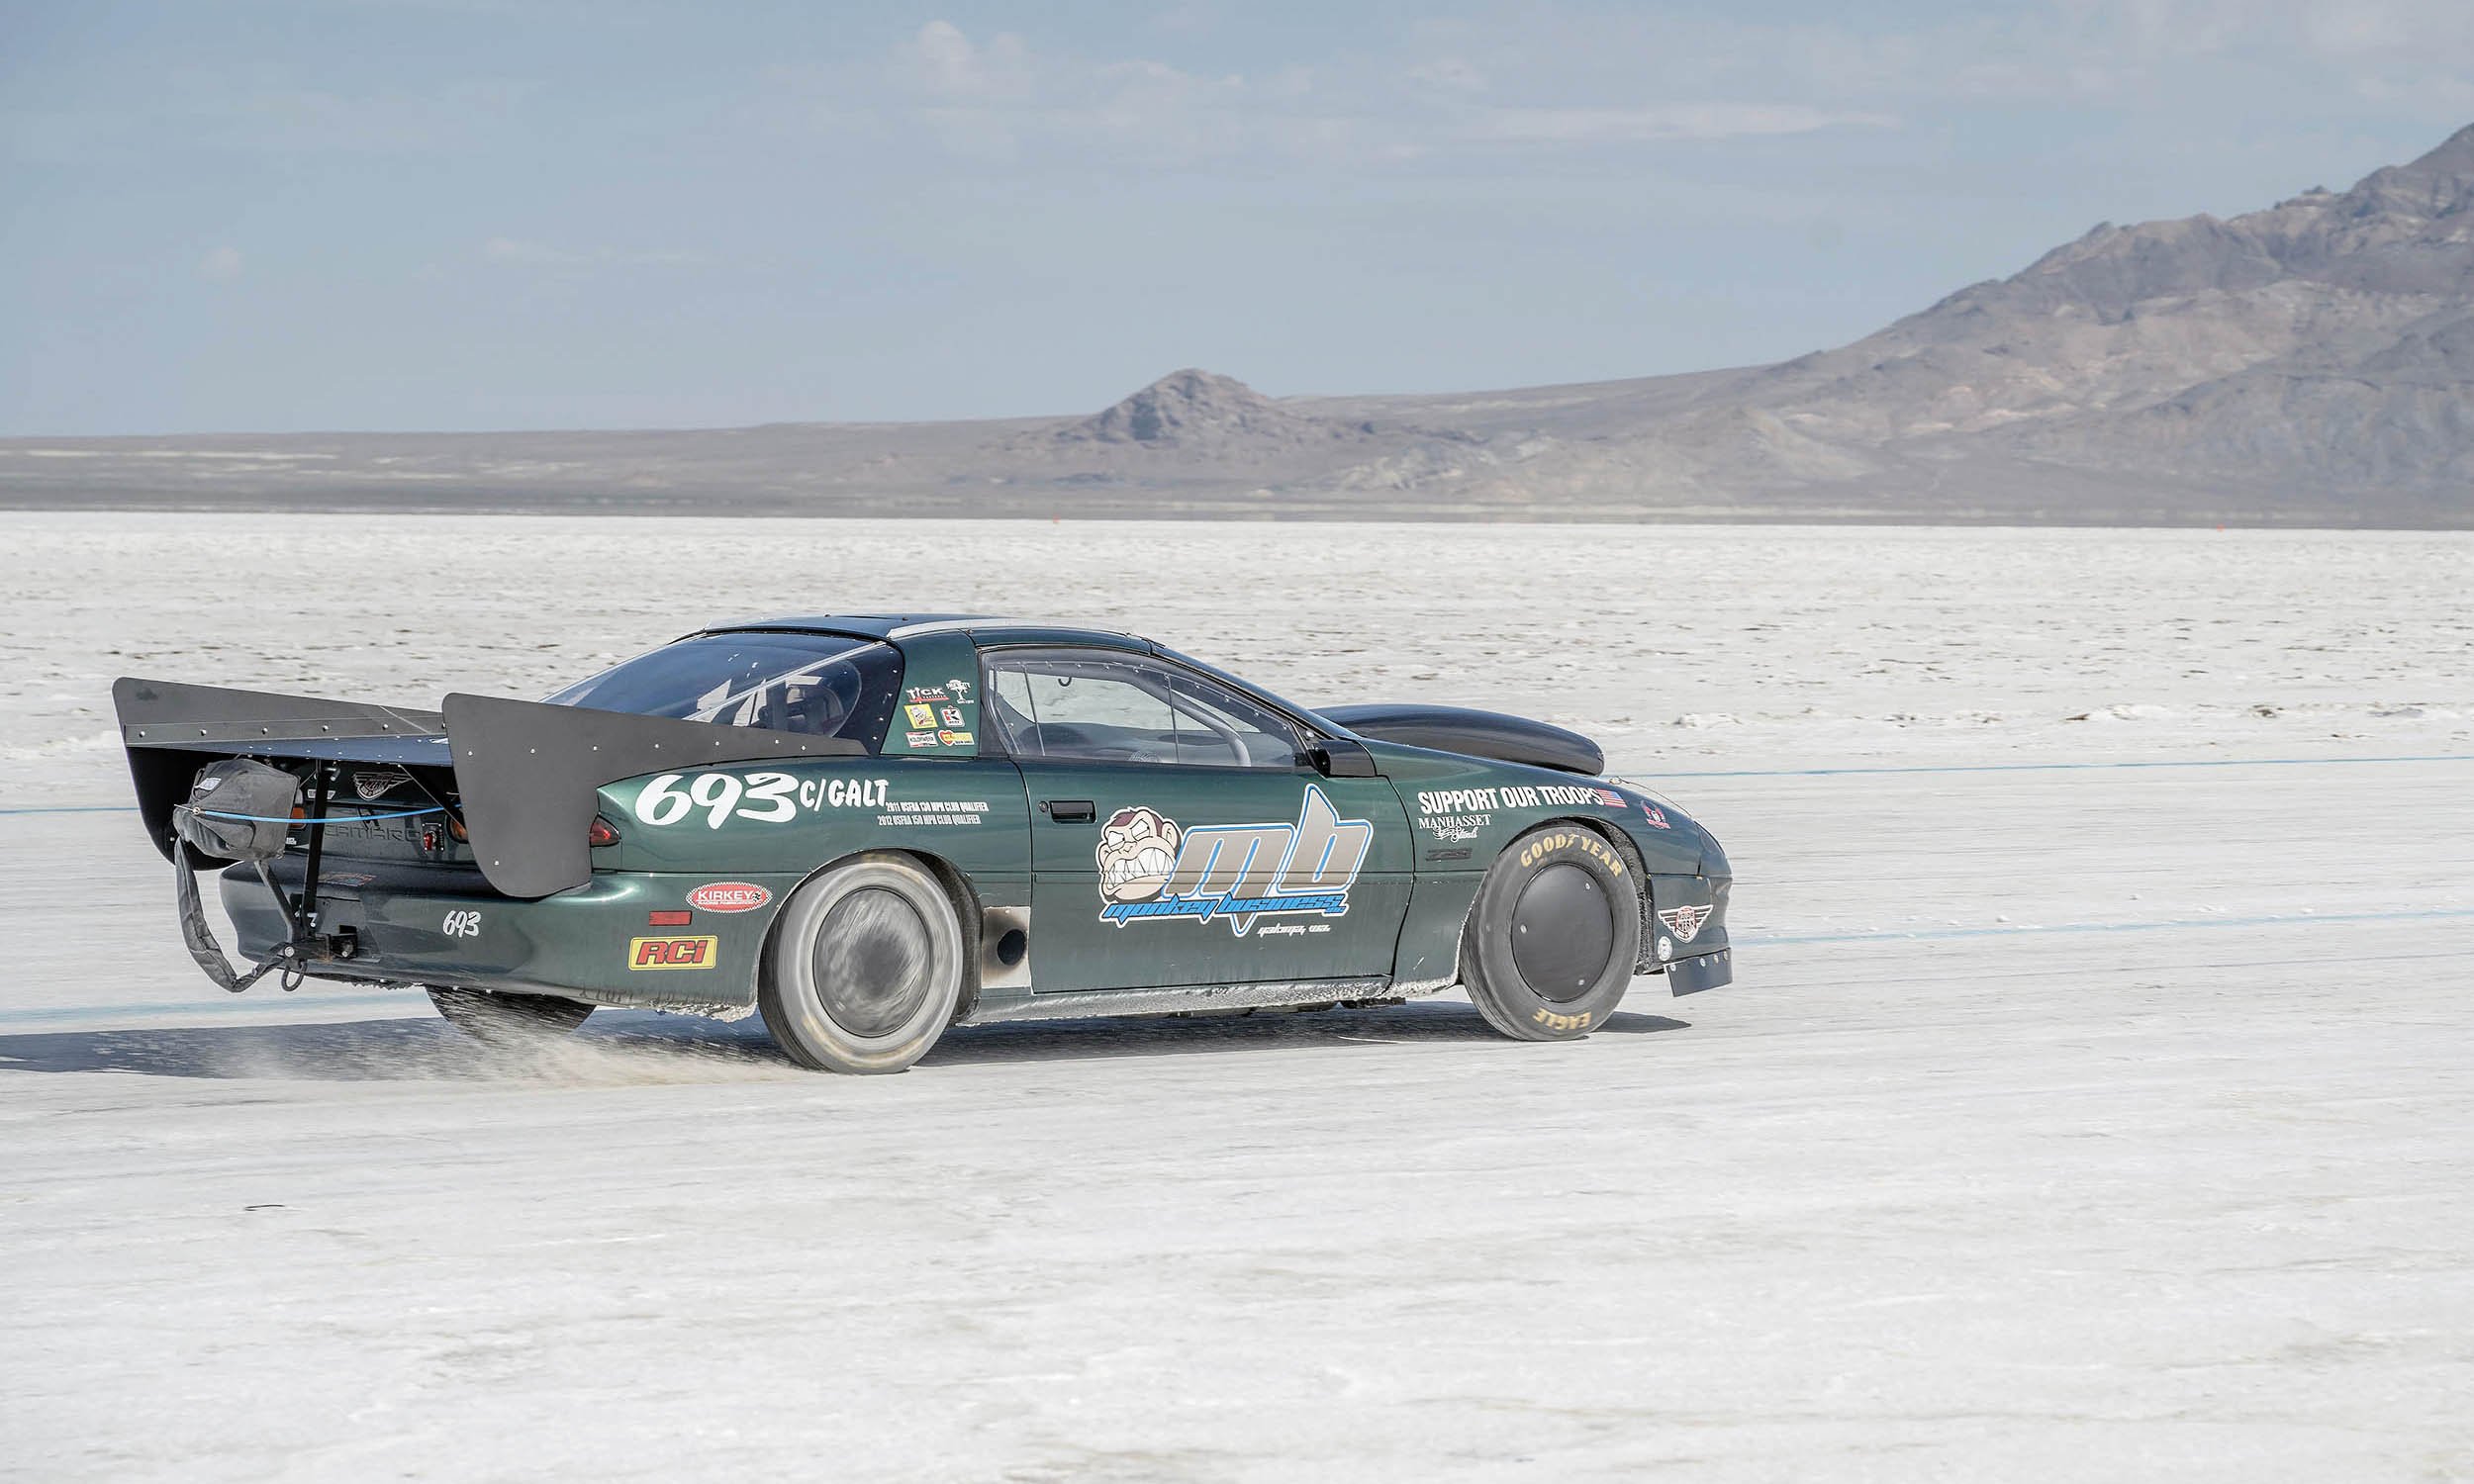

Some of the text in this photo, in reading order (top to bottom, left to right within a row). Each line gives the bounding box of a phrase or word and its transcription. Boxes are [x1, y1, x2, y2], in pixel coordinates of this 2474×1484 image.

[635, 773, 889, 829] 693 C/GALT
[959, 801, 990, 812] QUALIFIER
[1418, 786, 1605, 814] SUPPORT OUR TROOPS
[951, 814, 983, 825] QUALIFIER
[1417, 814, 1491, 829] MANHASSET
[698, 890, 754, 900] KIRKEY
[1101, 891, 1346, 925] monkey business
[442, 910, 481, 938] 693
[1532, 1007, 1591, 1030] EAGLE
